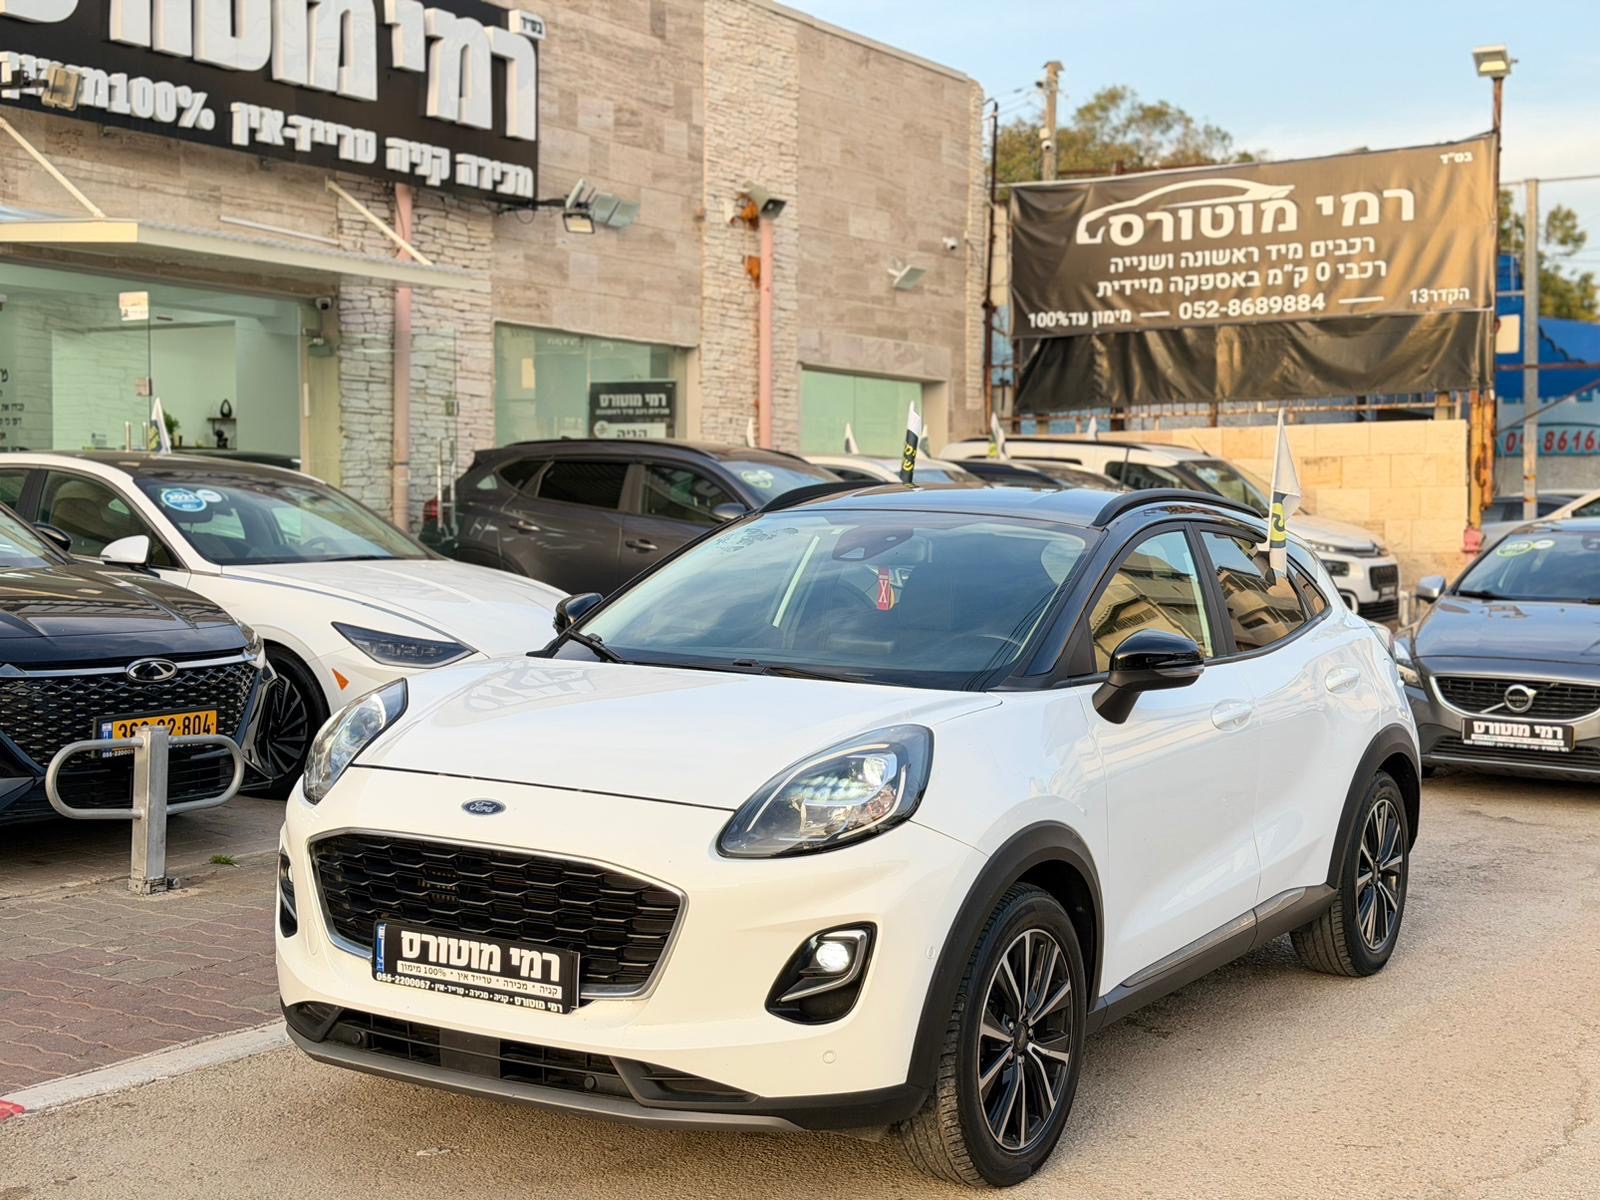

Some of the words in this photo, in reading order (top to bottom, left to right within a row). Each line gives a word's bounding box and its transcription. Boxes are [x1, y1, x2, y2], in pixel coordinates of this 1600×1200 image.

[385, 0, 536, 141] רמי
[230, 101, 376, 164] טרייד-אין
[385, 137, 450, 187] קניה
[1440, 152, 1473, 164] בס"ד
[455, 153, 535, 198] מכירה
[1315, 188, 1415, 227] רמי
[1108, 199, 1298, 246] מוטורס
[1180, 245, 1260, 268] ראשונה
[1265, 242, 1303, 261] מיד
[1310, 236, 1375, 258] רכבים
[1109, 251, 1174, 274] ושנייה
[1315, 261, 1331, 282] 0
[1337, 260, 1387, 280] רכבי
[1169, 270, 1261, 296] באספקה
[1267, 264, 1309, 287] ק"מ
[1097, 276, 1163, 298] מיידית
[1178, 292, 1326, 320] 052-8689884
[1092, 309, 1132, 328] מימון
[599, 394, 642, 408] מוטורס
[644, 393, 667, 407] רמי
[1473, 720, 1531, 737] מוטורס
[1533, 725, 1563, 739] רמי
[401, 930, 501, 973] מוטורס
[400, 963, 422, 973] מימון
[424, 966, 447, 977] 100%
[509, 947, 560, 982] רמי
[457, 972, 469, 981] אין
[470, 973, 492, 985] טרייד
[503, 979, 528, 991] מכירה
[468, 988, 489, 999] מכירה
[493, 993, 509, 1004] קניה
[539, 985, 558, 997] קניה
[514, 996, 546, 1009] מוטורס
[547, 1002, 563, 1013] רמי
